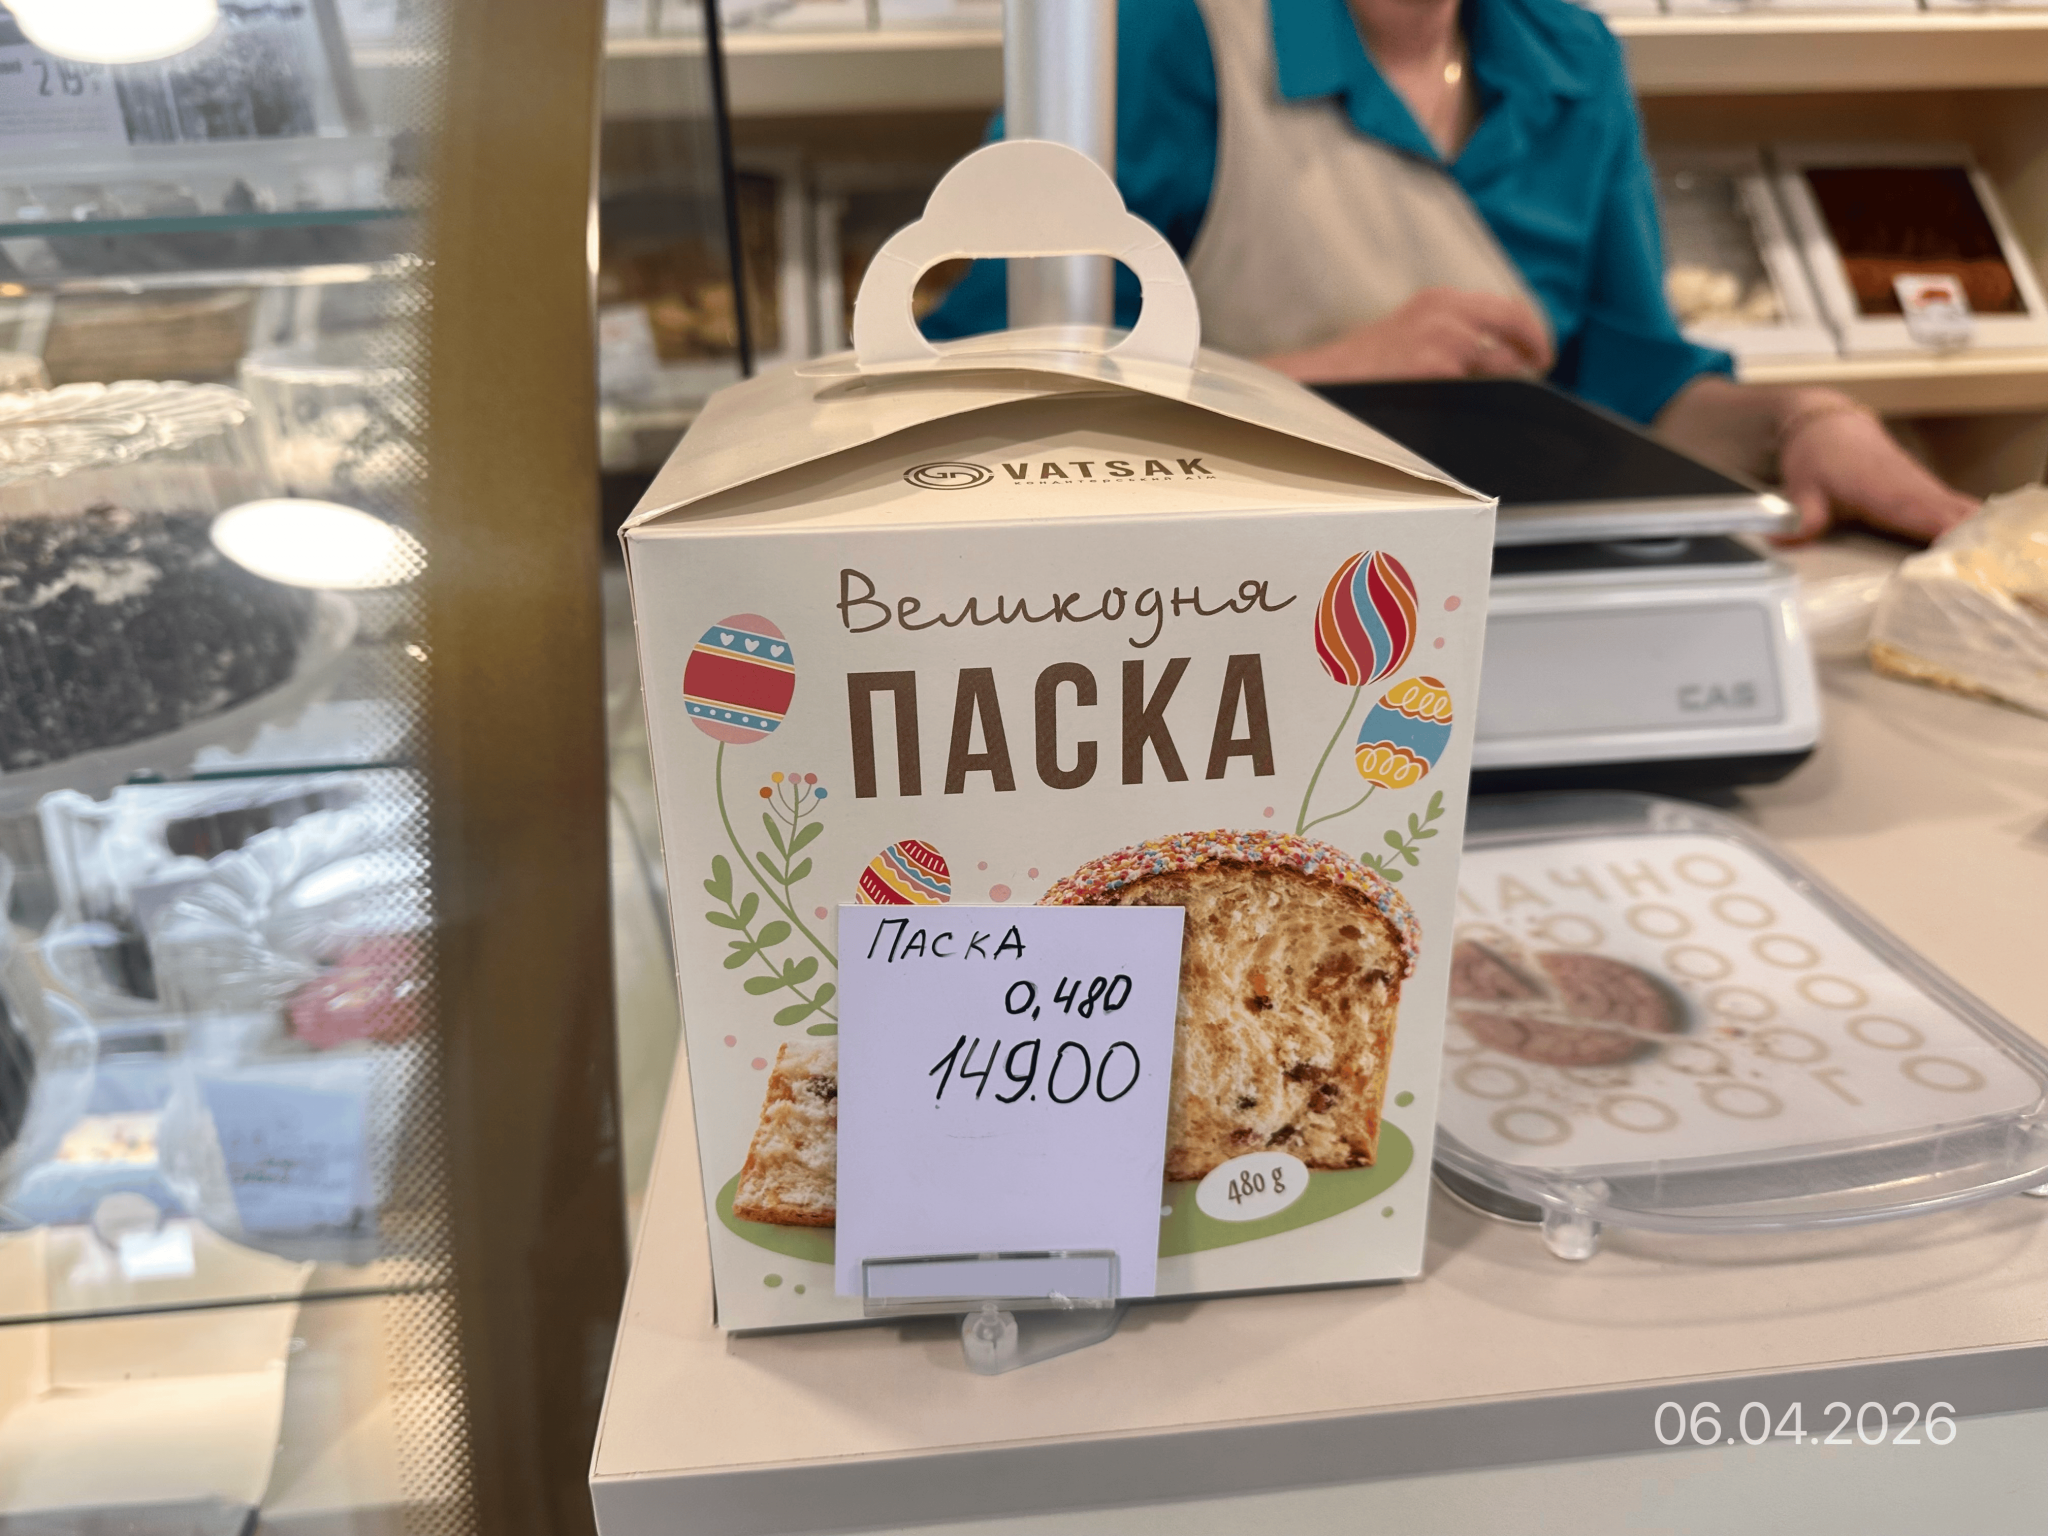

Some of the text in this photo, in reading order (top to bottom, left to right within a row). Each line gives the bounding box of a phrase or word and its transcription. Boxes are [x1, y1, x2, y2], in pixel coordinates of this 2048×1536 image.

[1001, 457, 1214, 480] VATSAK
[836, 566, 1298, 649] Великодня
[846, 652, 1277, 800] ПАСКА
[1004, 973, 1133, 1022] 0,480
[928, 1034, 1141, 1104] 149.00
[1227, 1166, 1286, 1205] 480 g
